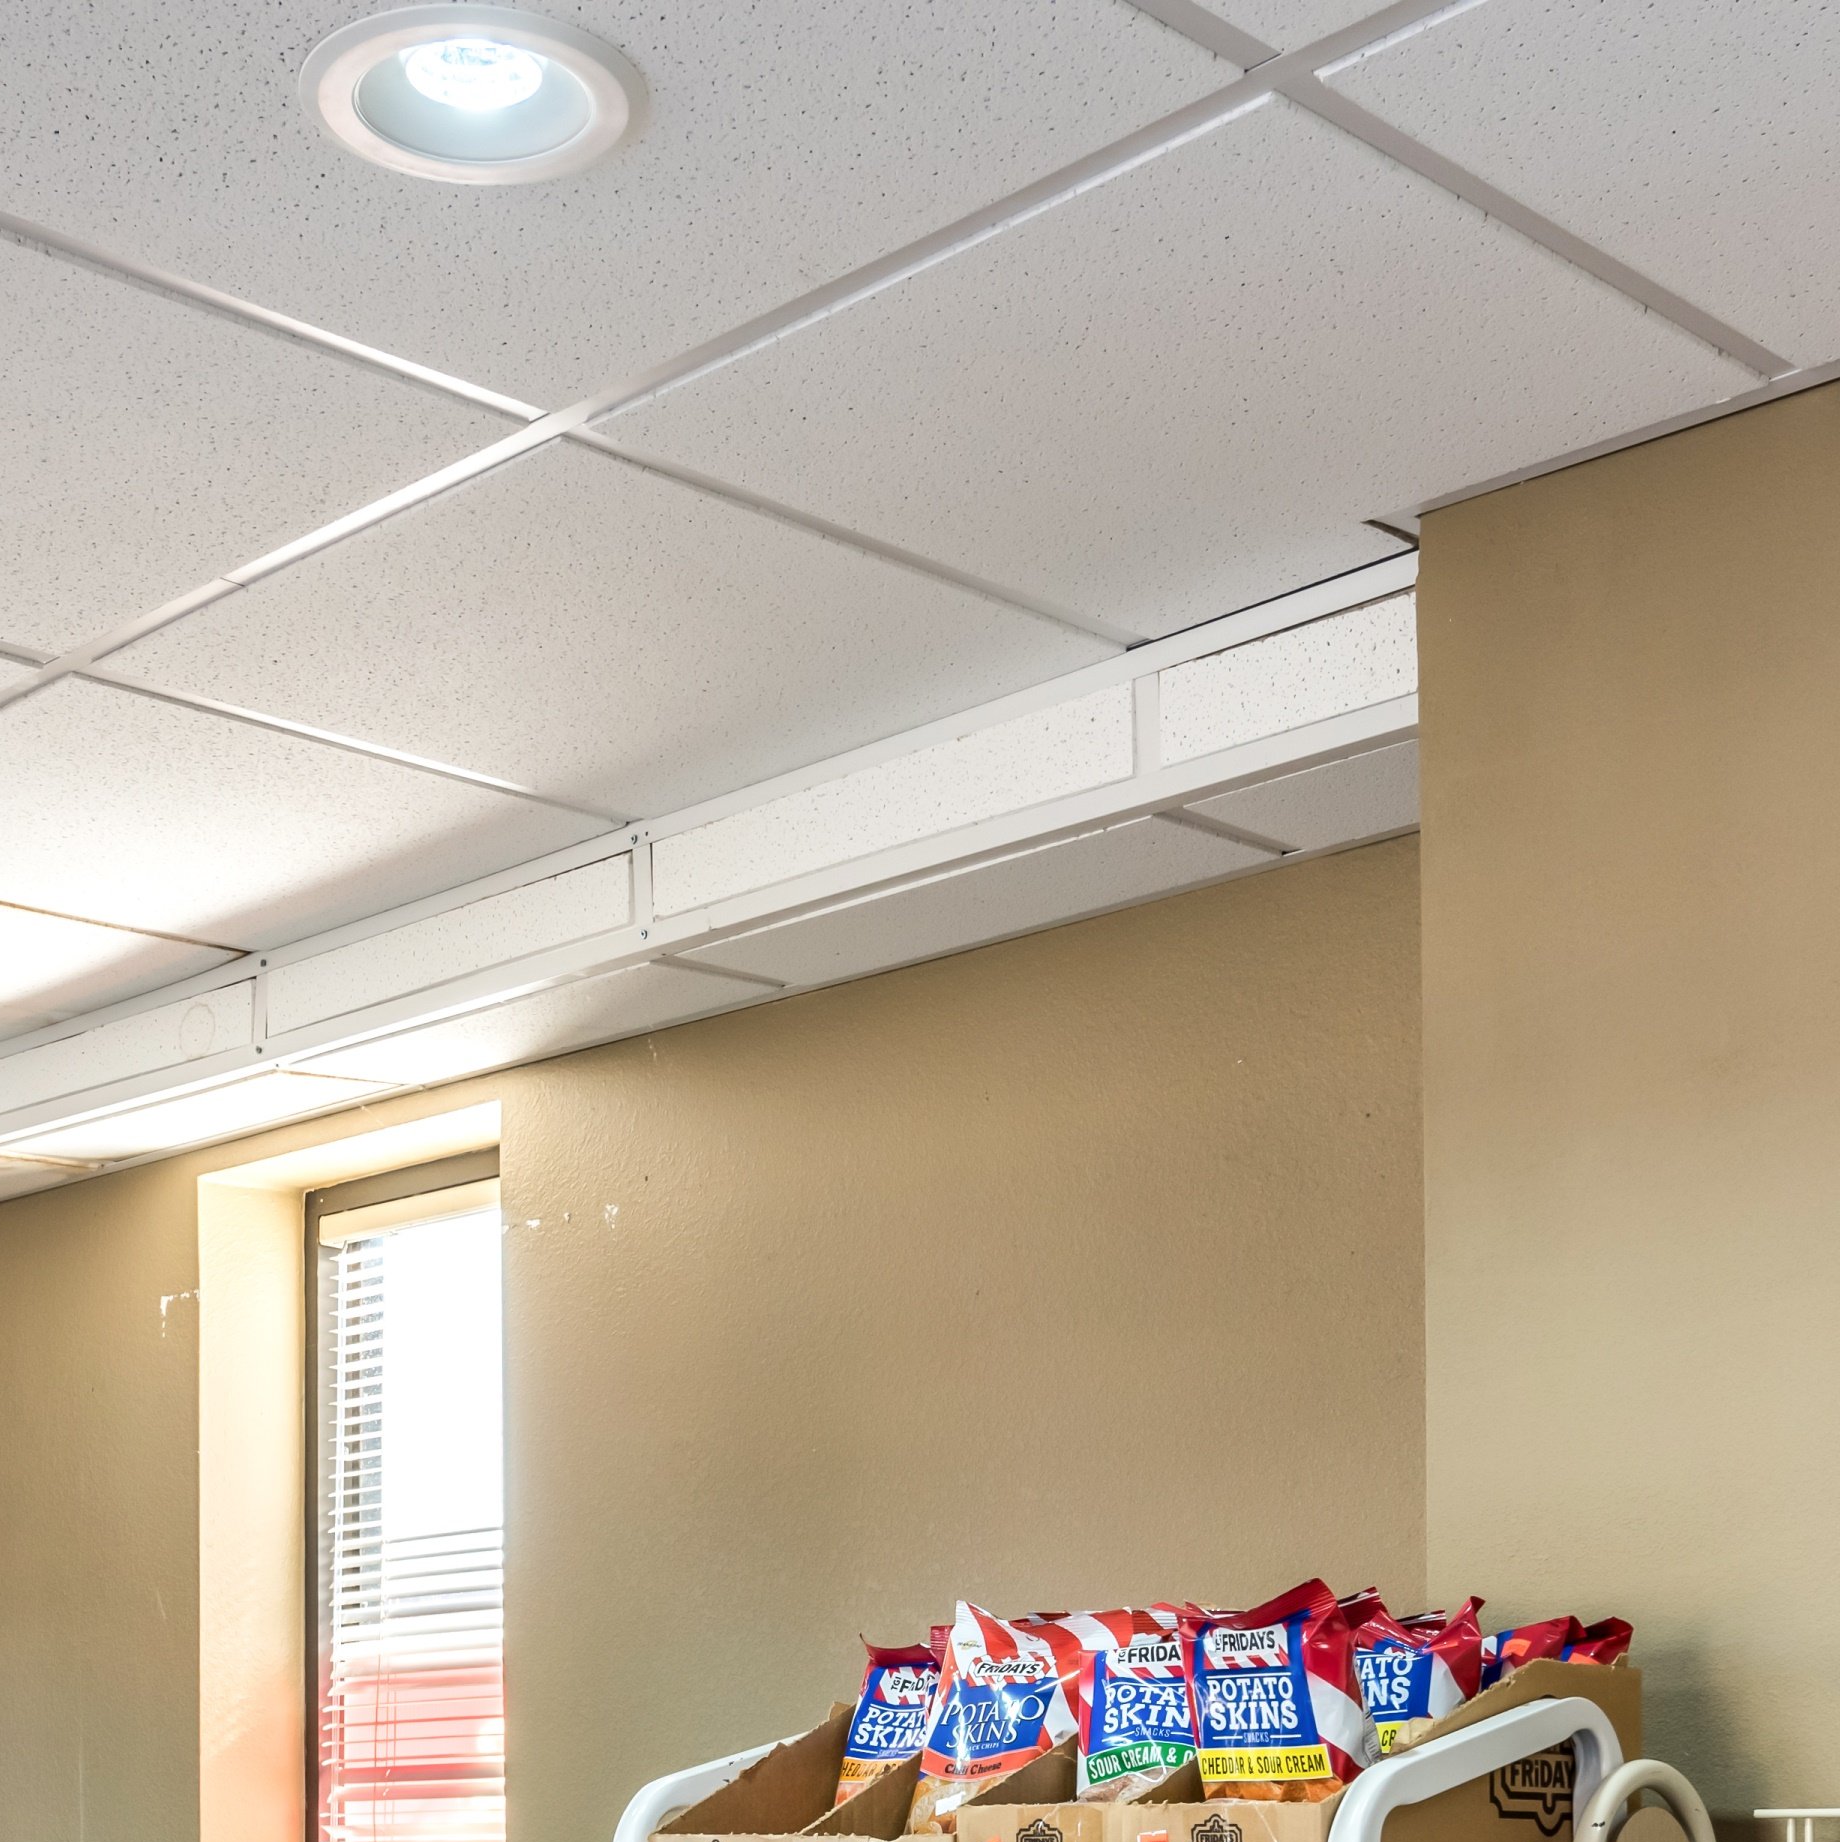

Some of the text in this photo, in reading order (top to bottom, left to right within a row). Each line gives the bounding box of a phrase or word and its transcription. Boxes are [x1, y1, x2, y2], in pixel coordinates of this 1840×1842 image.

[1223, 1630, 1275, 1651] FRIDAYS
[1208, 1676, 1293, 1701] POTATO
[941, 1695, 1044, 1725] POTATO
[1210, 1701, 1298, 1731] SKINS
[946, 1719, 1020, 1749] SKINS
[1134, 1726, 1171, 1737] SNACKS
[1091, 1748, 1177, 1780] SOUR CREAM &
[1202, 1754, 1325, 1775] CHEDDAR & SOUR CREAM
